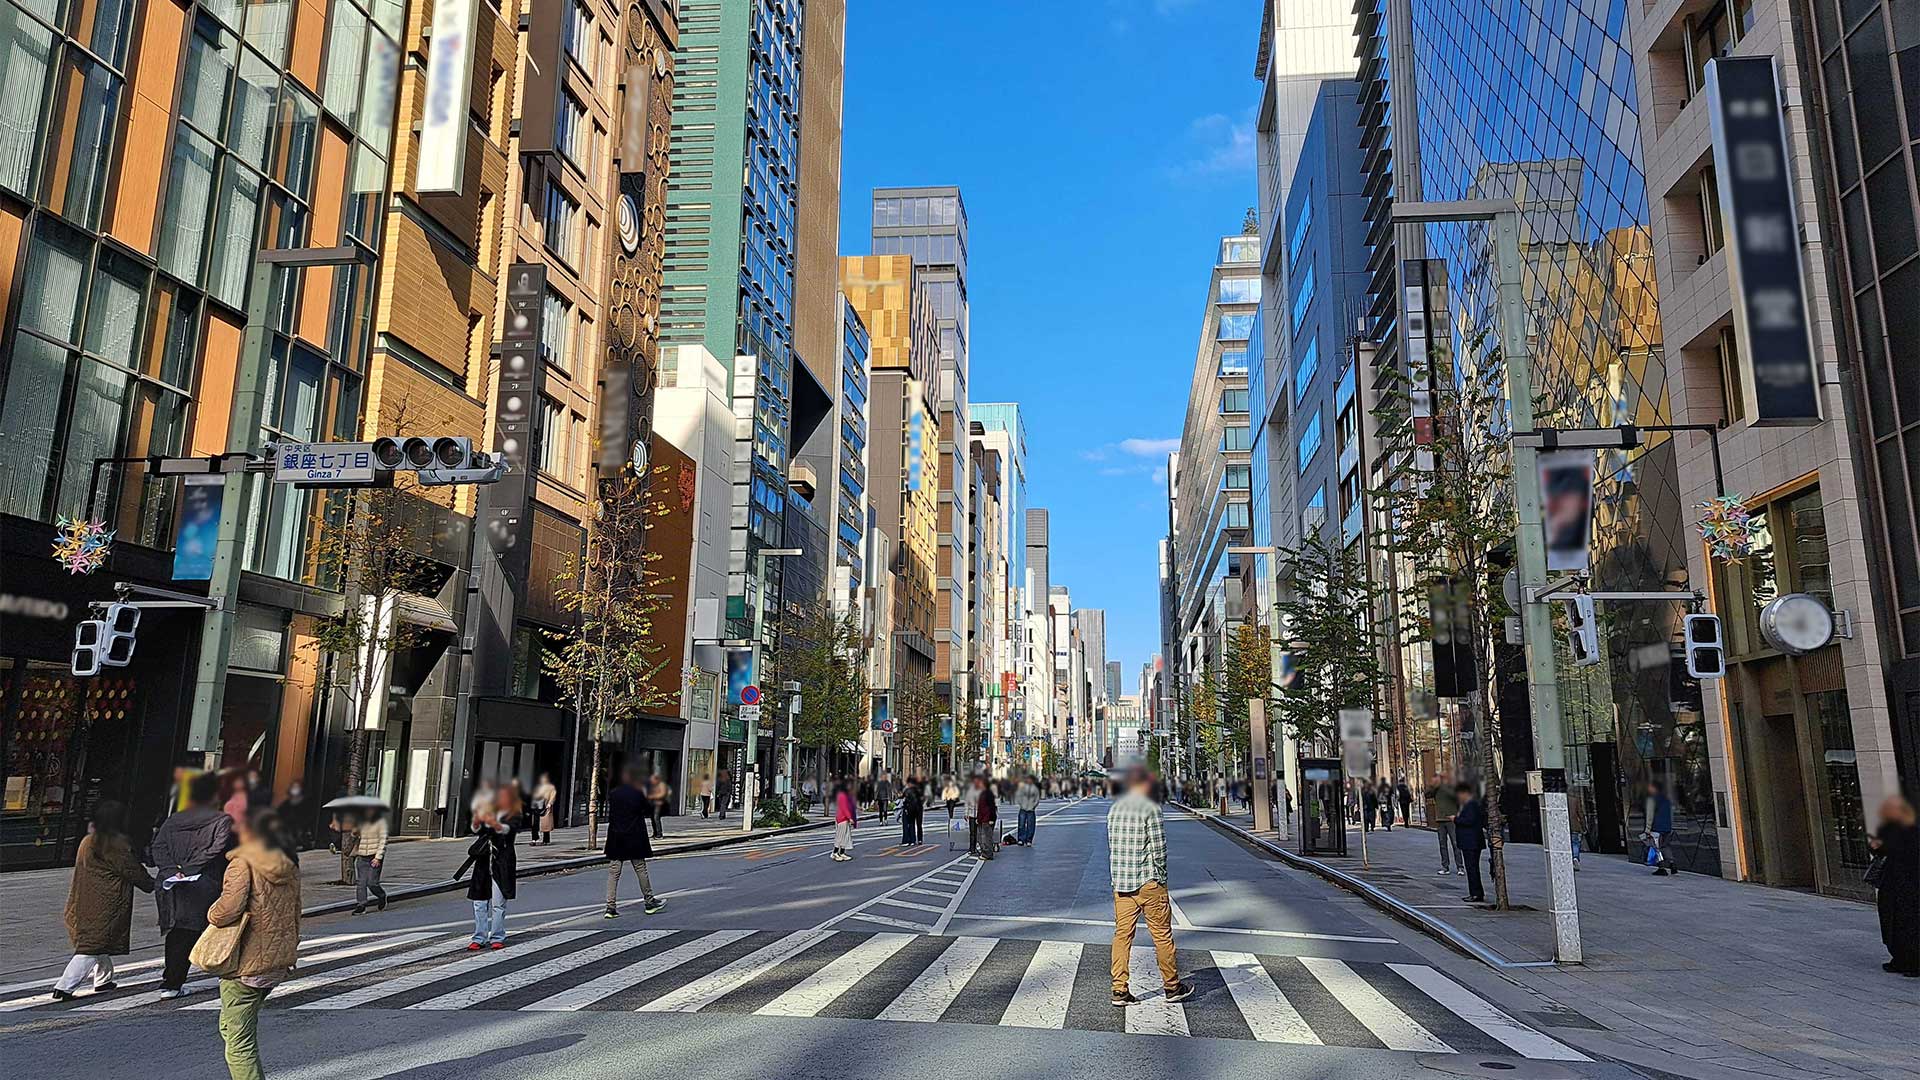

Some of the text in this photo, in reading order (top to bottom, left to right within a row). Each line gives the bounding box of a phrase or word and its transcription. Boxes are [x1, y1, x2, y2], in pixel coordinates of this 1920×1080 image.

[284, 445, 312, 453] 中央区
[283, 452, 369, 469] 銀座七丁目
[307, 469, 342, 479] Ginza 7
